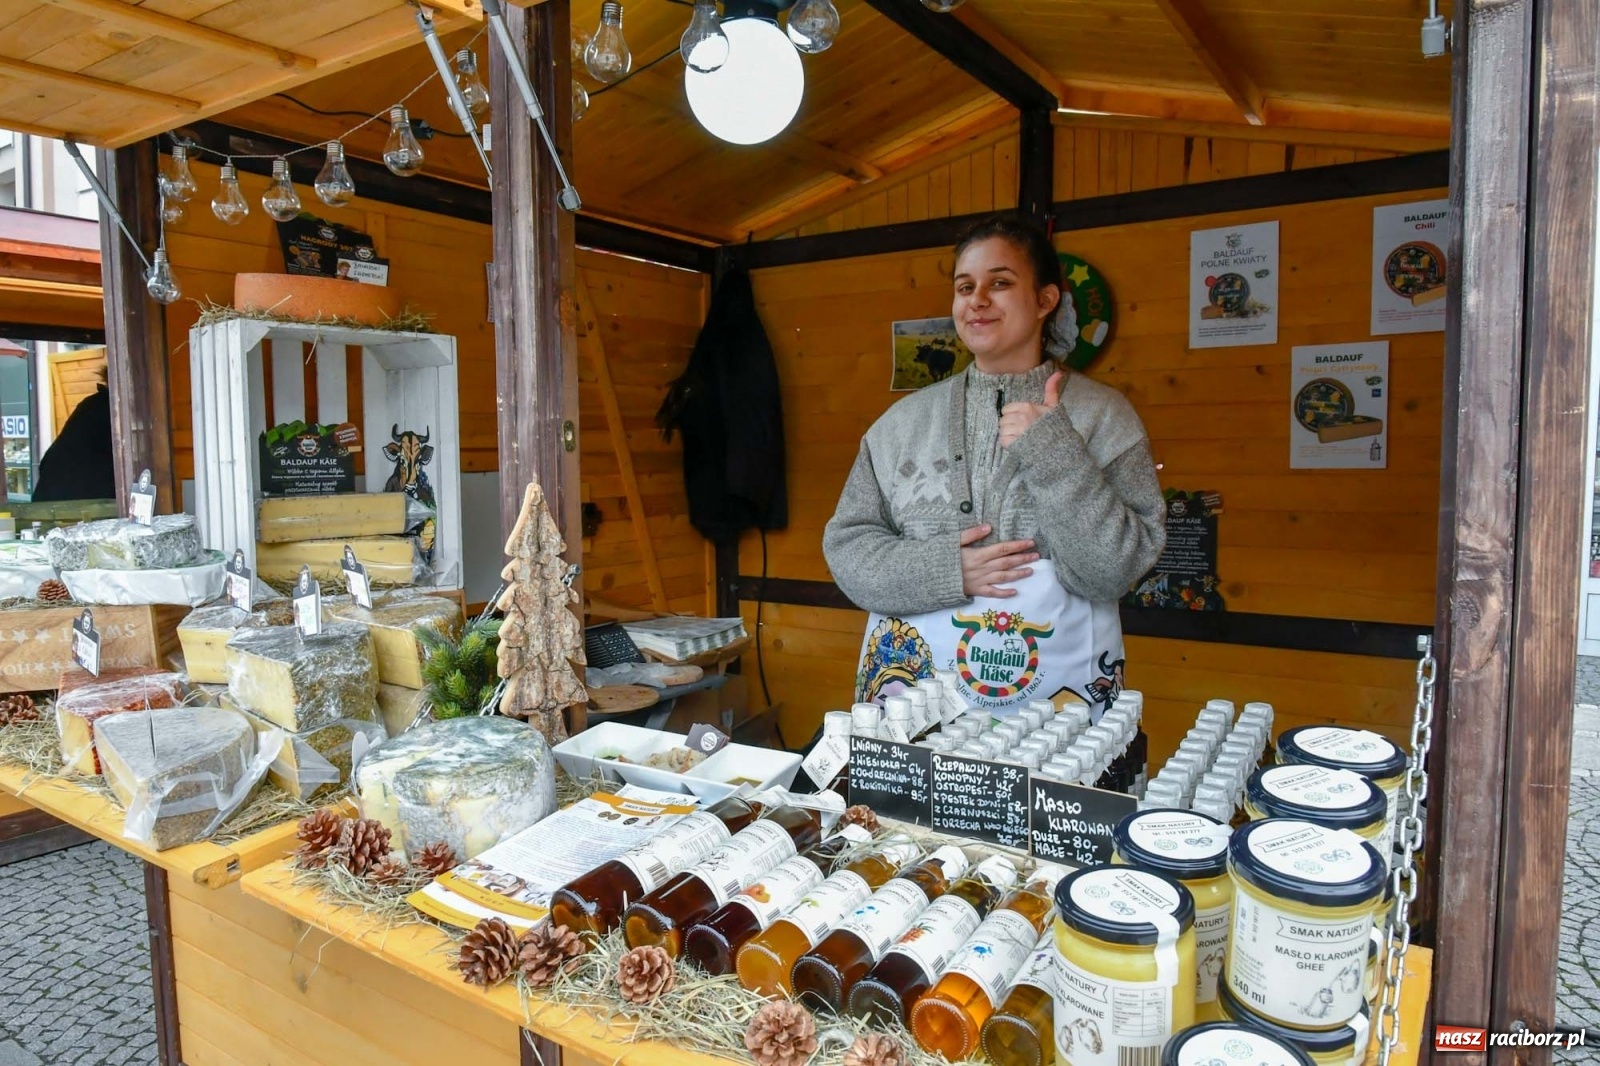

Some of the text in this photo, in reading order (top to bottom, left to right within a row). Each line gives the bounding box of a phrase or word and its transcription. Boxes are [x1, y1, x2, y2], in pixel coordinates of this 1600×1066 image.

[1404, 211, 1448, 222] BALDAUF
[1415, 222, 1435, 230] Chili
[1214, 247, 1254, 259] BALDAUF
[1200, 255, 1268, 268] POLNE KWIATY
[1316, 353, 1364, 364] BALDAUF
[320, 457, 338, 465] KÄSE
[970, 645, 1027, 667] Baldauf
[980, 664, 1014, 683] Käse
[1026, 678, 1042, 694] 1862
[934, 770, 982, 785] KONOPNY
[1048, 814, 1115, 838] KLAROWAN
[1126, 878, 1163, 904] SMAK NATURY
[1290, 924, 1363, 938] SMAK NATURY
[1275, 943, 1366, 961] MASŁO KLAROWANE
[1296, 961, 1325, 972] GHEE
[1065, 972, 1097, 994] NATURY
[1233, 975, 1266, 1005] 340 ml
[1060, 988, 1105, 1019] KLAROWANE
